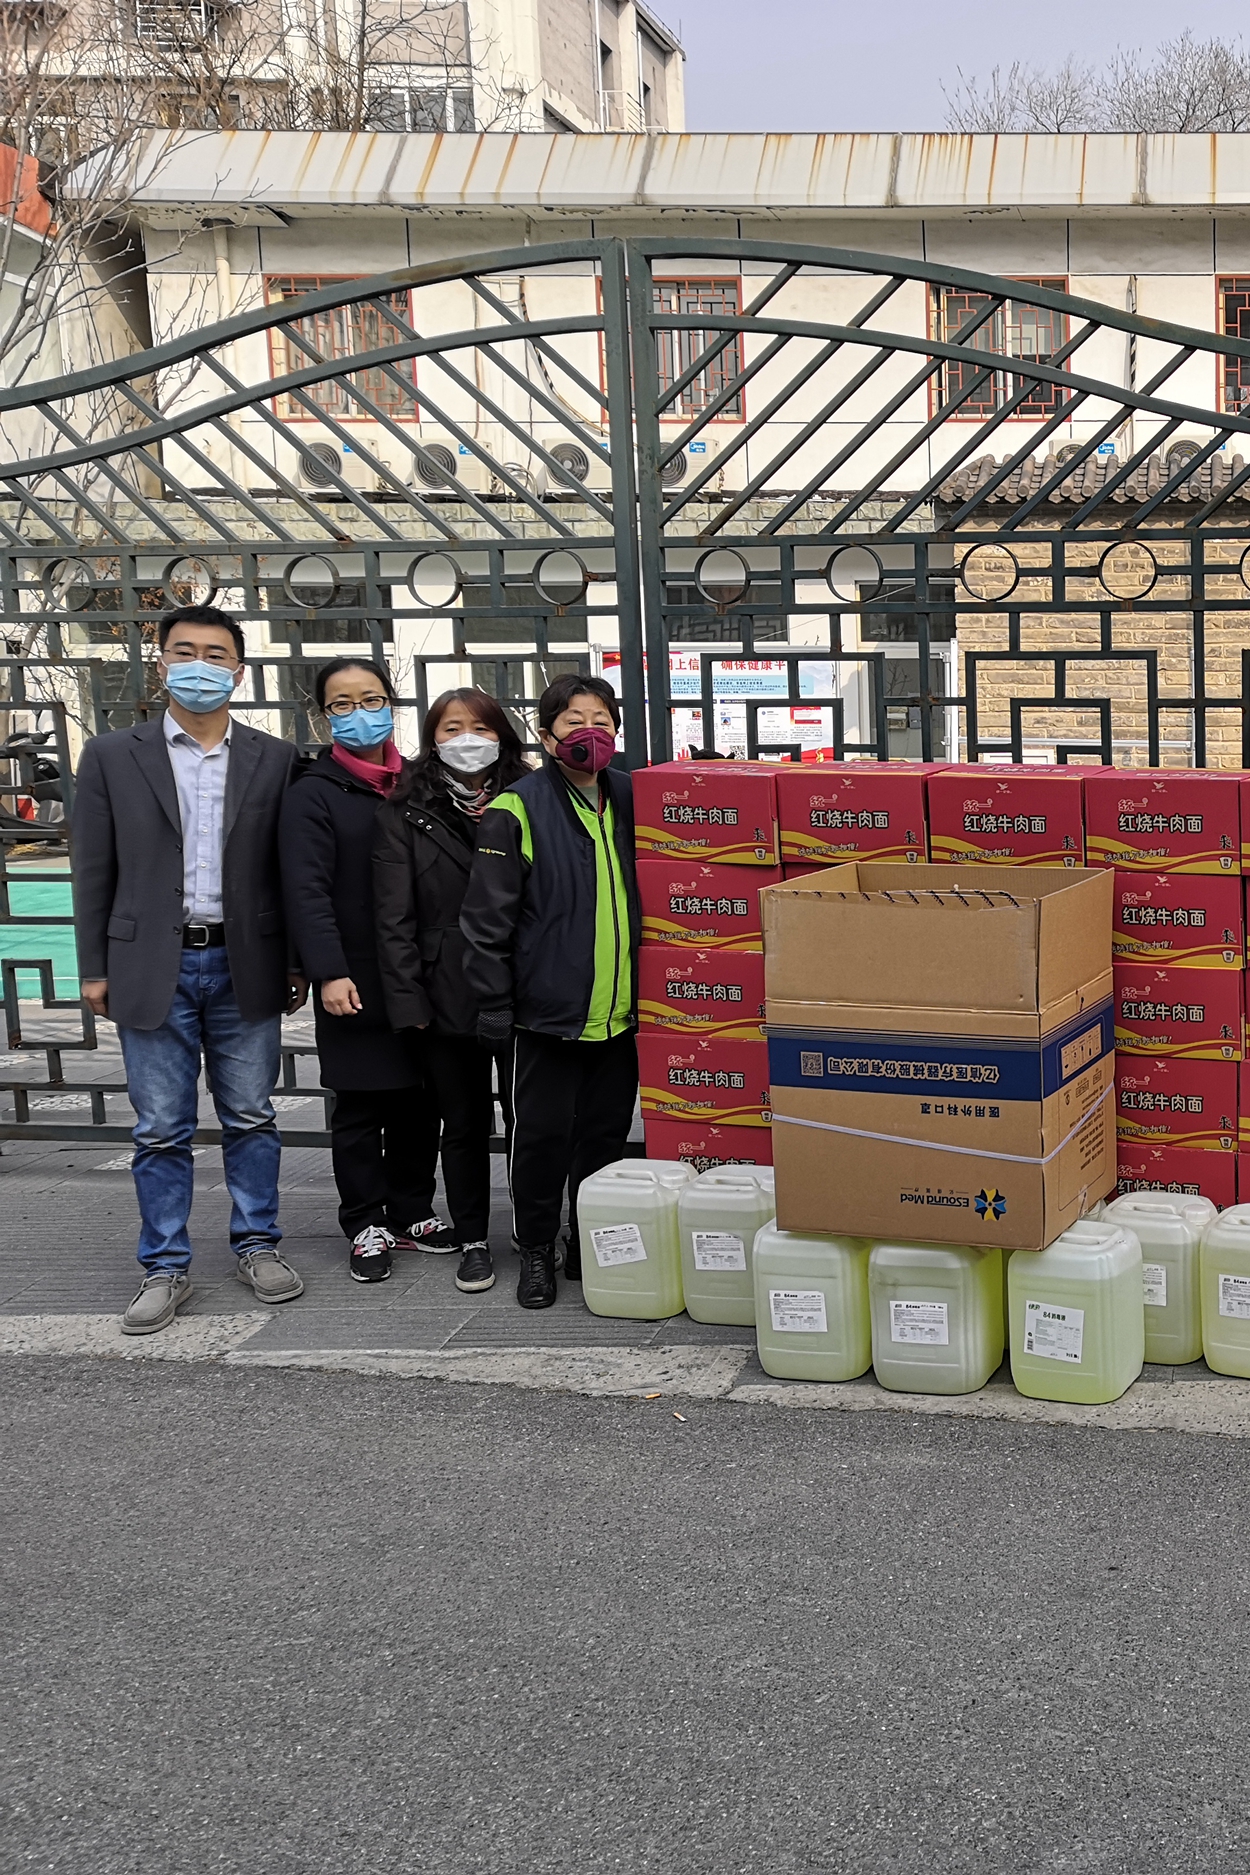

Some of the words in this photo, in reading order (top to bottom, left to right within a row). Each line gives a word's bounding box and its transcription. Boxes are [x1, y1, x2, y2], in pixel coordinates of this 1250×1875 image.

[663, 805, 738, 825] 红烧牛肉面
[810, 809, 890, 829] 红烧牛肉面
[964, 814, 1047, 834] 红烧牛肉面
[1119, 813, 1203, 834] 红烧牛肉面
[670, 896, 748, 916] 红烧牛肉面
[1122, 907, 1206, 927] 红烧牛肉面
[666, 981, 742, 1001] 红烧牛肉面
[1122, 1001, 1205, 1022] 红烧牛肉面
[669, 1068, 744, 1088] 红烧牛肉面
[827, 1055, 1000, 1083] 亿信医疗器械股份有限公司
[920, 1102, 1000, 1118] 医用外科口罩
[1121, 1091, 1203, 1113] 红烧牛肉面
[900, 1193, 924, 1205] Med
